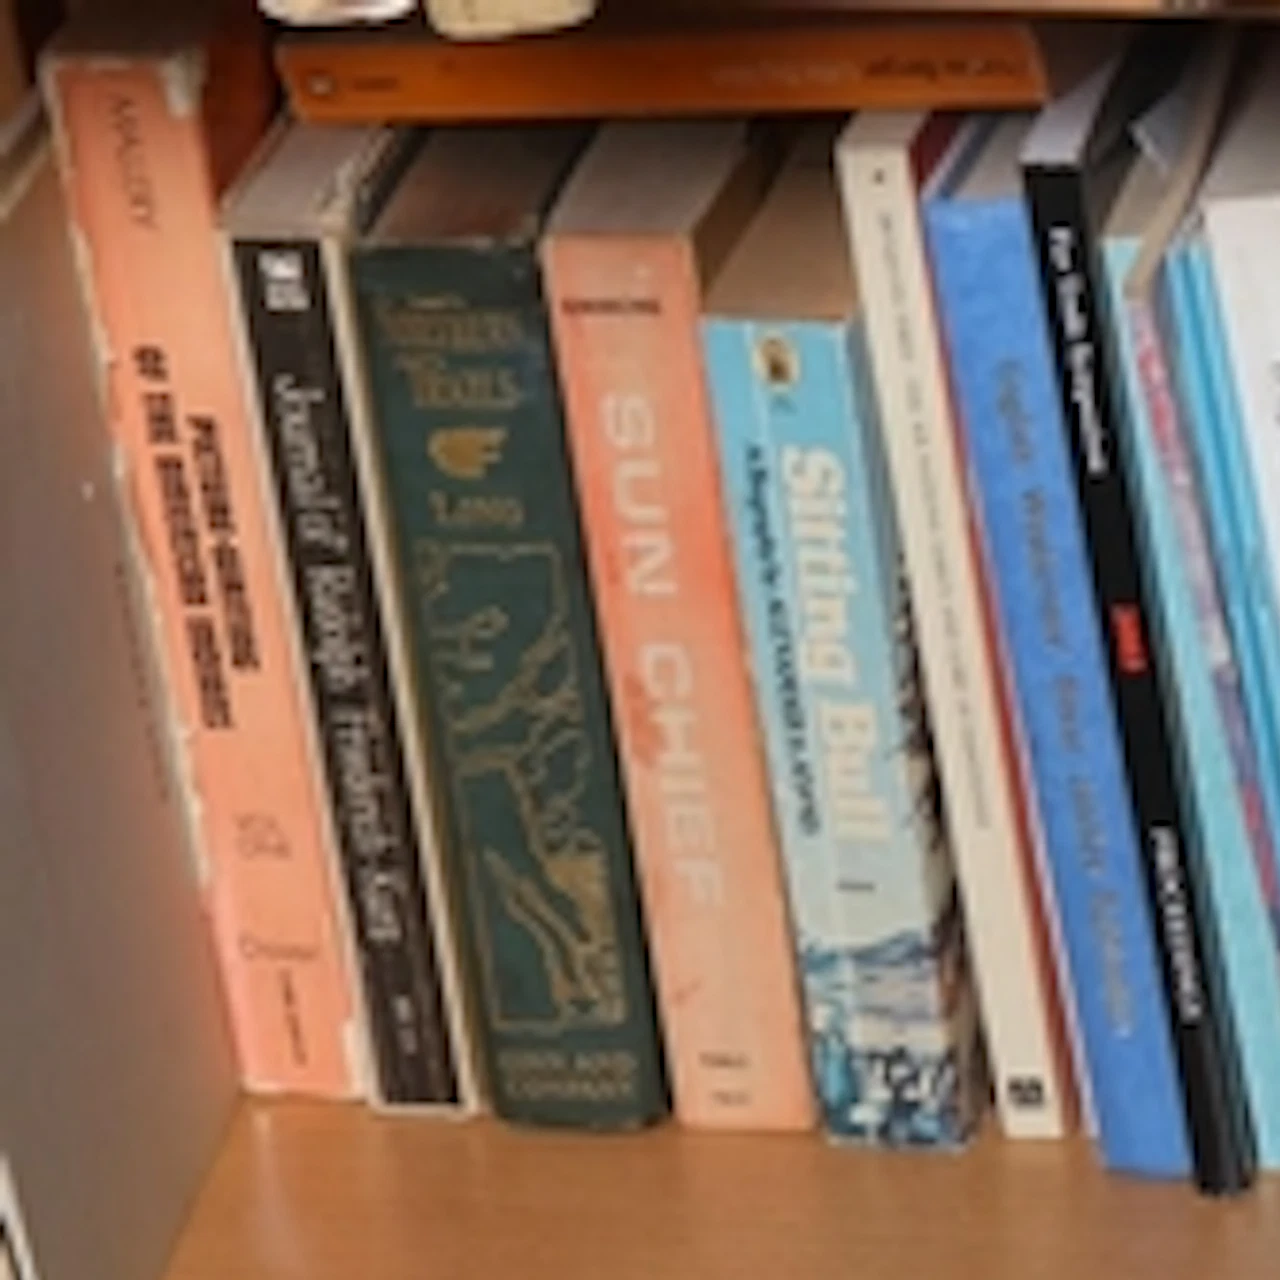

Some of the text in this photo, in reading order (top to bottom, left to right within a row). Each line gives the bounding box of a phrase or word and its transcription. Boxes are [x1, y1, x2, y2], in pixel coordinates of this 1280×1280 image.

[140, 391, 178, 446] THE
[273, 371, 332, 505] Journal
[298, 503, 348, 551] of
[606, 393, 725, 908] SUN CHIEF
[780, 445, 890, 845] Sitting Bull
[1150, 826, 1203, 1025] PROCEEDINGS
